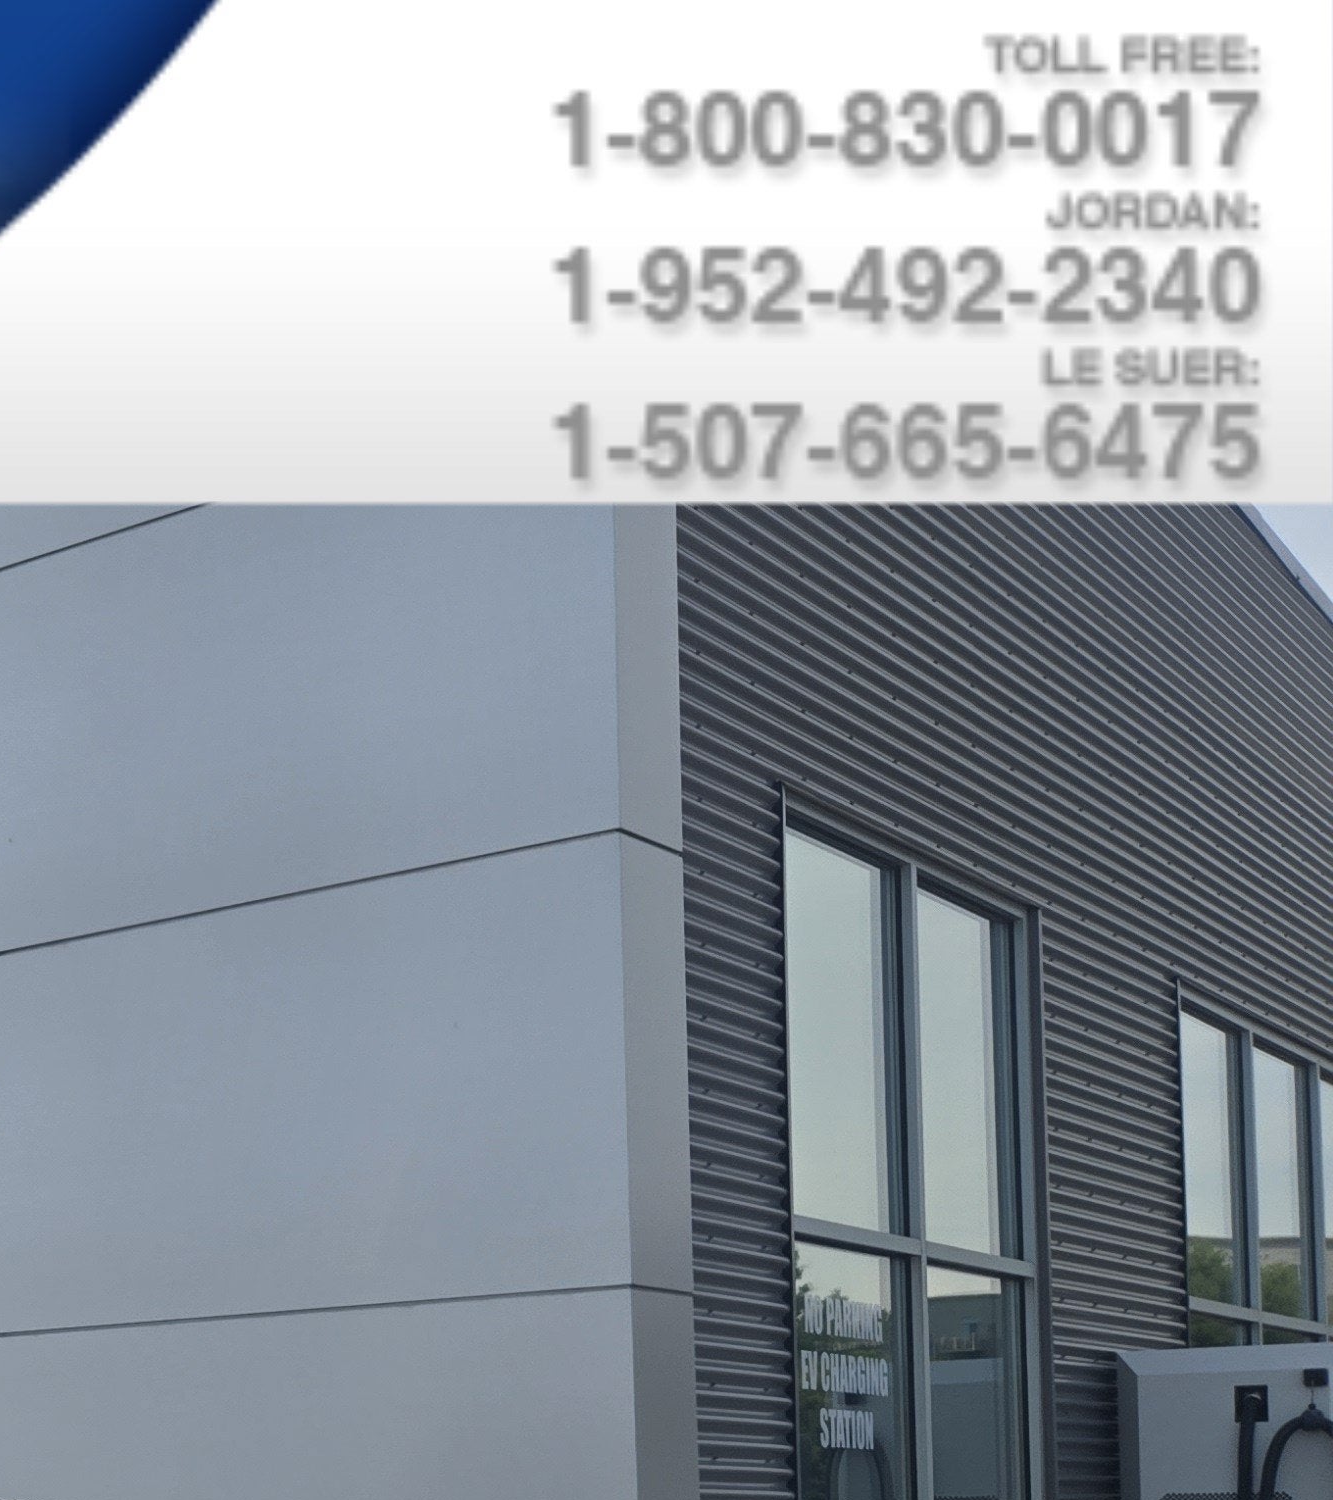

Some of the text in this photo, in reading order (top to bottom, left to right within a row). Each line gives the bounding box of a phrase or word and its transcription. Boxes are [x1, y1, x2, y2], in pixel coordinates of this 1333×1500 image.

[804, 1293, 824, 1335] NO
[800, 1349, 889, 1397] EV CHARGING
[819, 1407, 874, 1450] STATION
